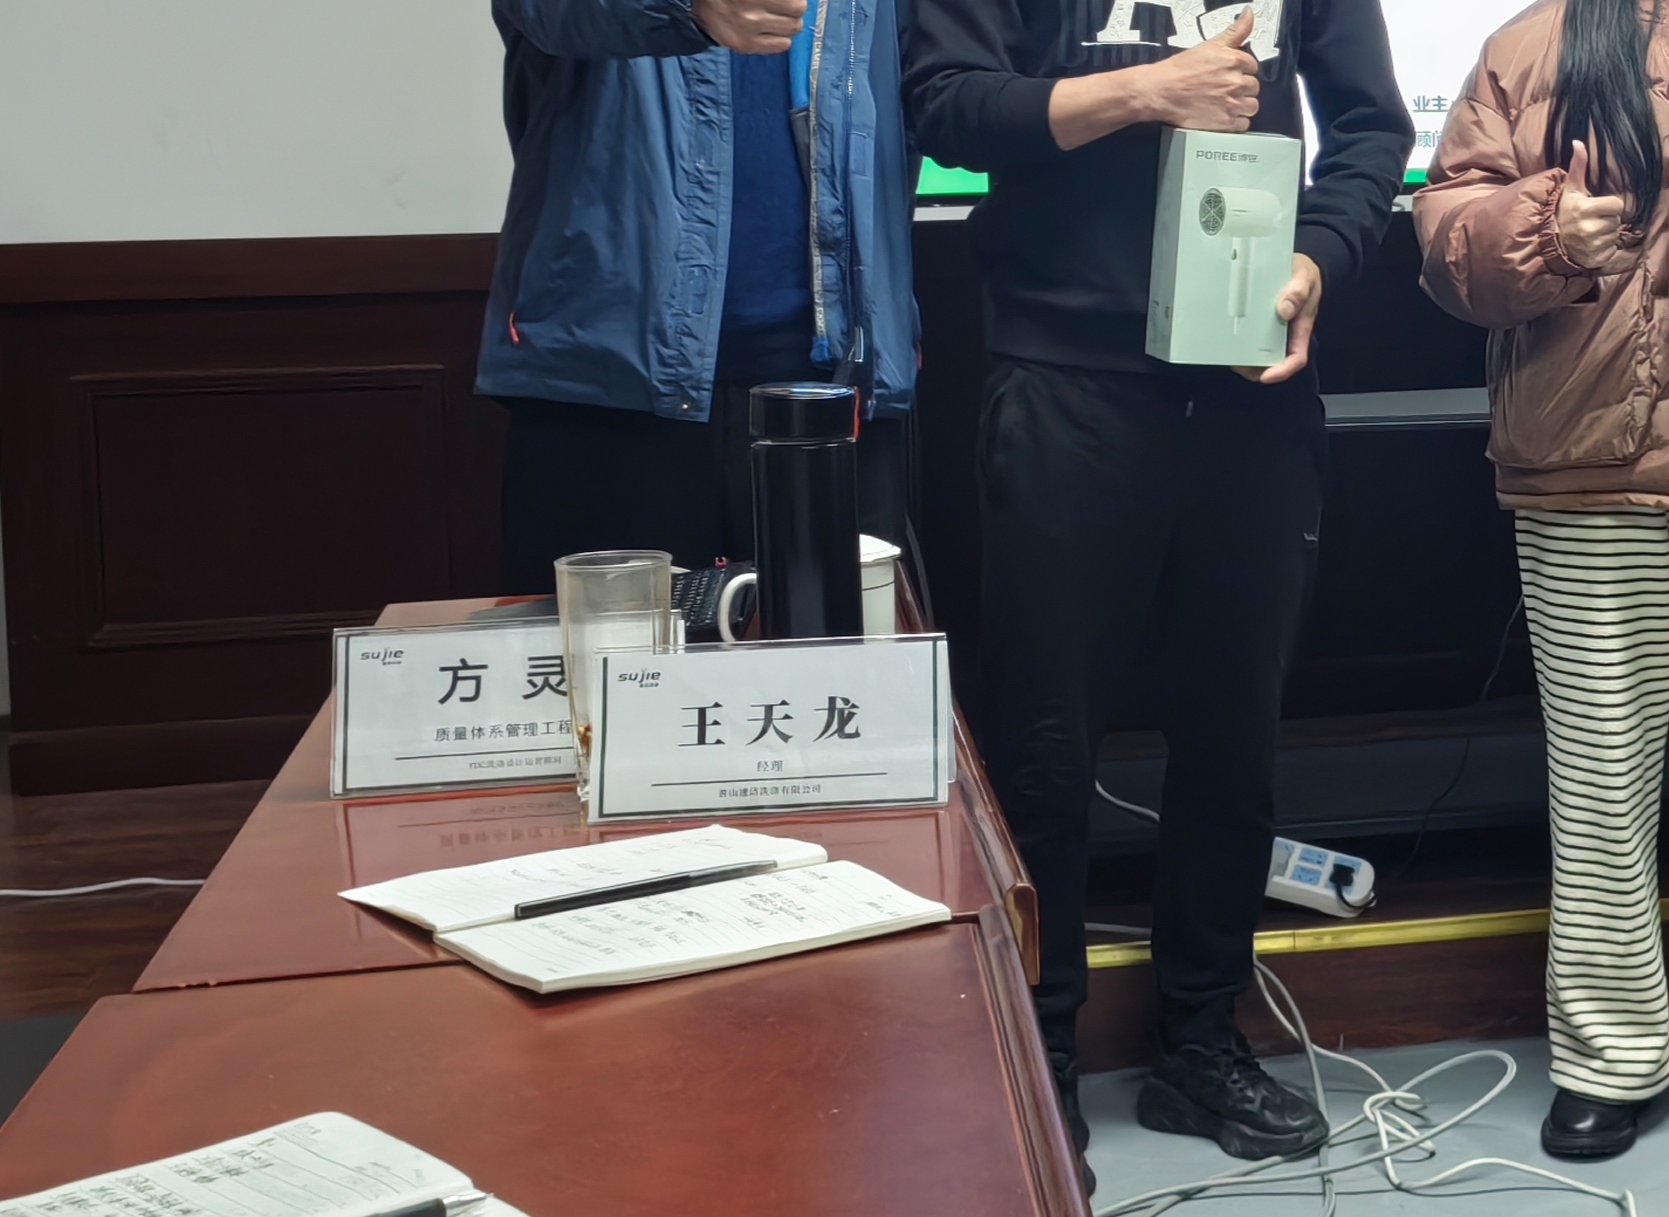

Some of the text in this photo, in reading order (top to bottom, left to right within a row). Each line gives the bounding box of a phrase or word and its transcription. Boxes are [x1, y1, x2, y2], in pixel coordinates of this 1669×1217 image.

[1413, 95, 1455, 112] 业主
[618, 670, 661, 683] sujie
[678, 696, 861, 747] 王天龙
[757, 760, 783, 772] 经理
